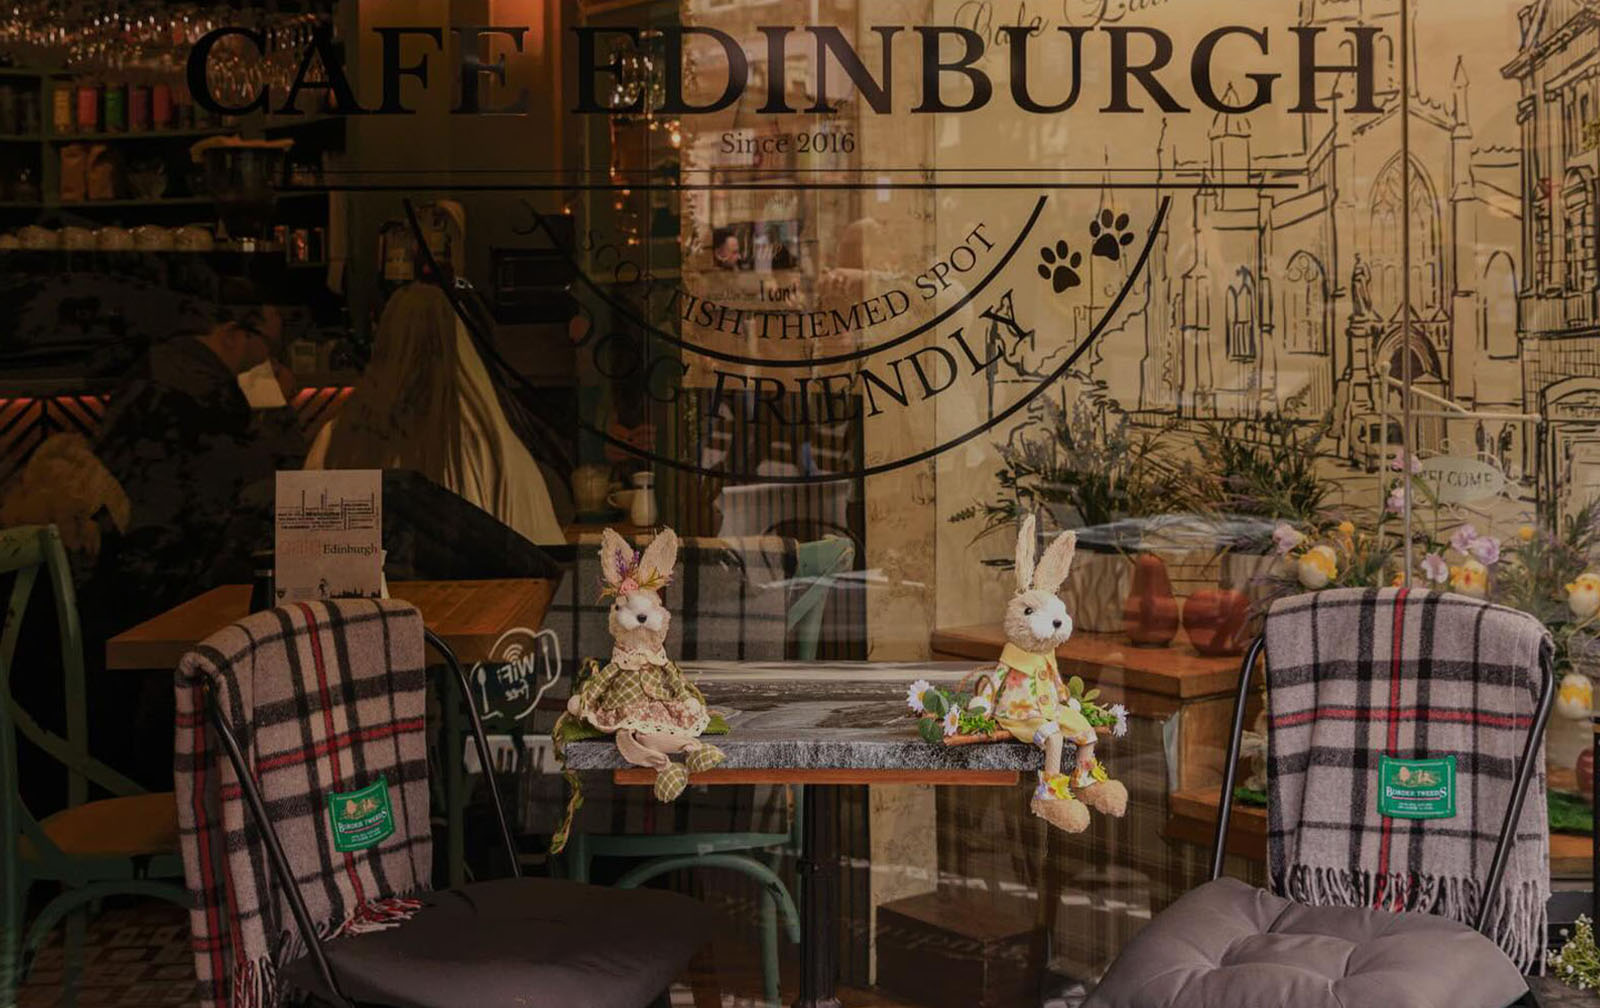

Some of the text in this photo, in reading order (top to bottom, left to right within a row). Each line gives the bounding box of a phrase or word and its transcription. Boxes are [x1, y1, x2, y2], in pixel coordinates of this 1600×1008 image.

[187, 26, 1385, 115] CAFE EDINBURGH
[720, 132, 855, 154] Since 2016
[753, 289, 910, 340] THEMED
[915, 222, 995, 301] SPOT
[704, 288, 1035, 425] FRIENDLY
[323, 543, 378, 556] Edinburgh
